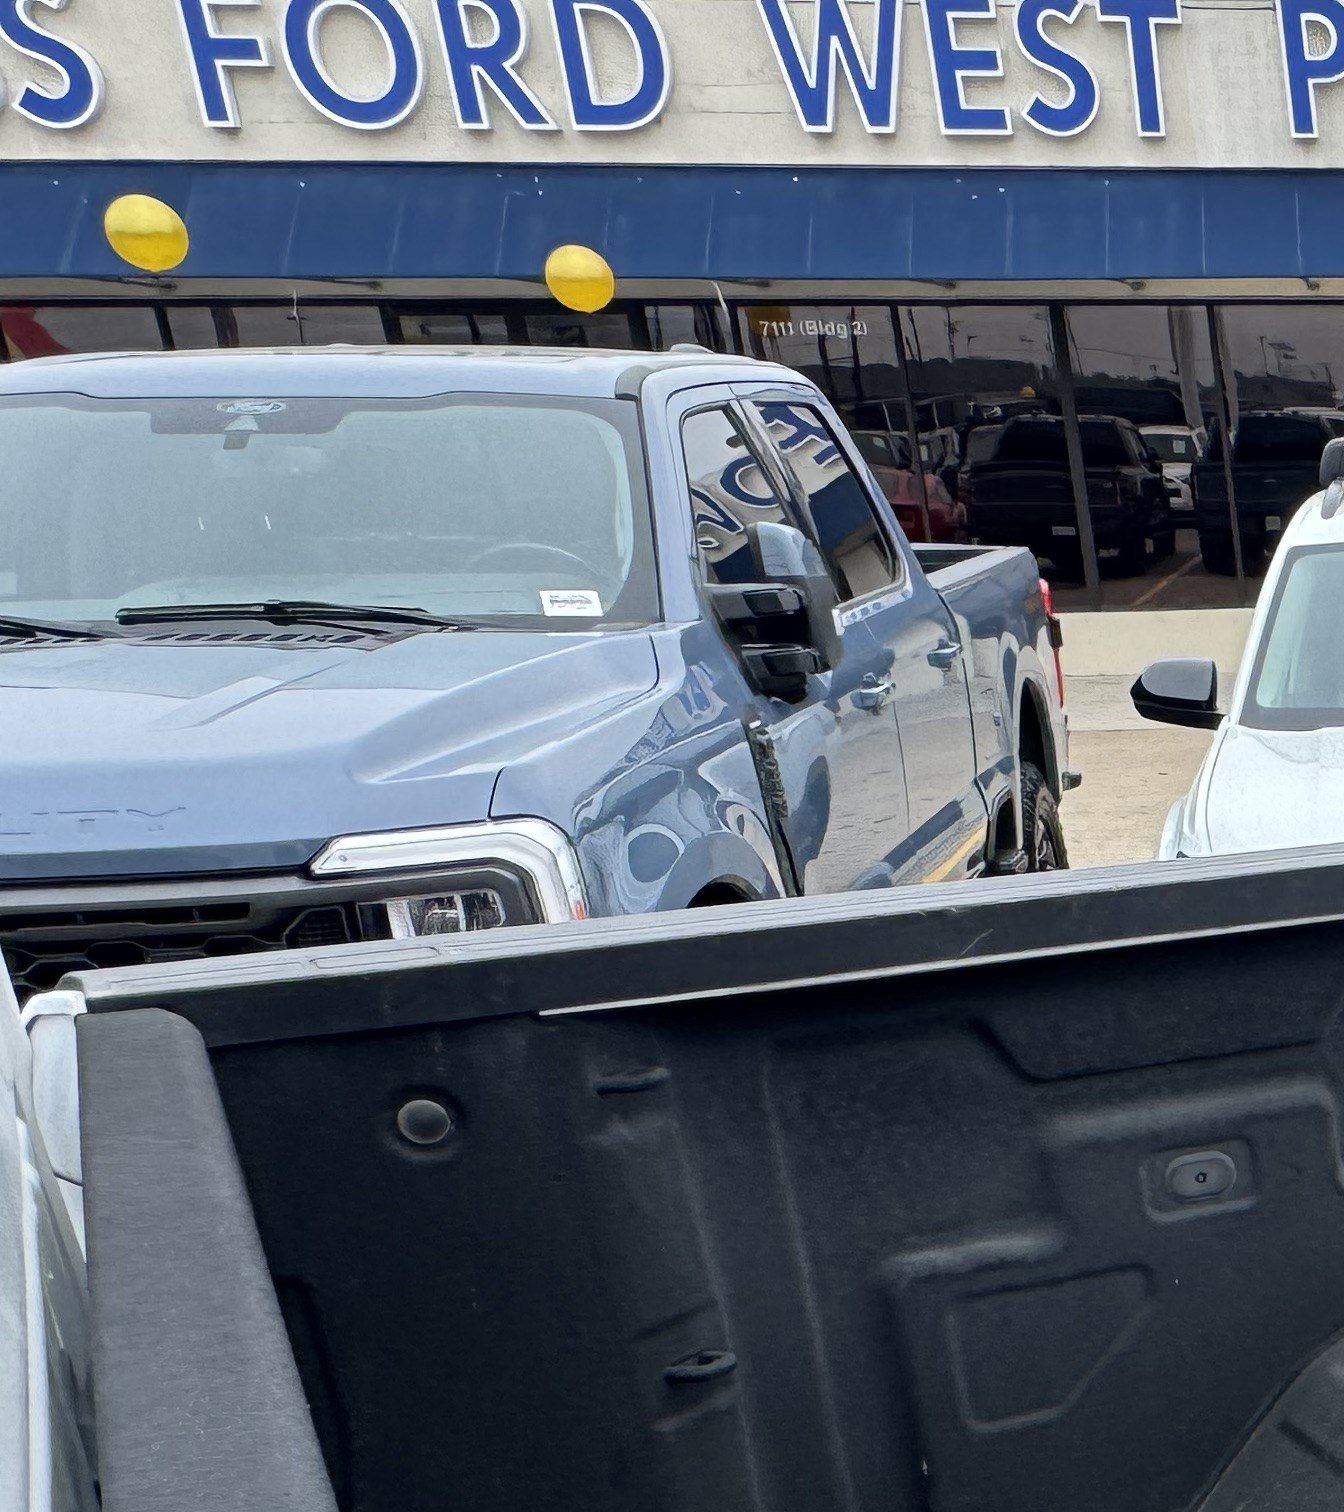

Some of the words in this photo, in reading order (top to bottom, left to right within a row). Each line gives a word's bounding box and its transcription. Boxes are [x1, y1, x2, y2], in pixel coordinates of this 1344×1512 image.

[177, 0, 674, 131] FORD
[756, 0, 1183, 138] WEST
[851, 321, 868, 336] 2)
